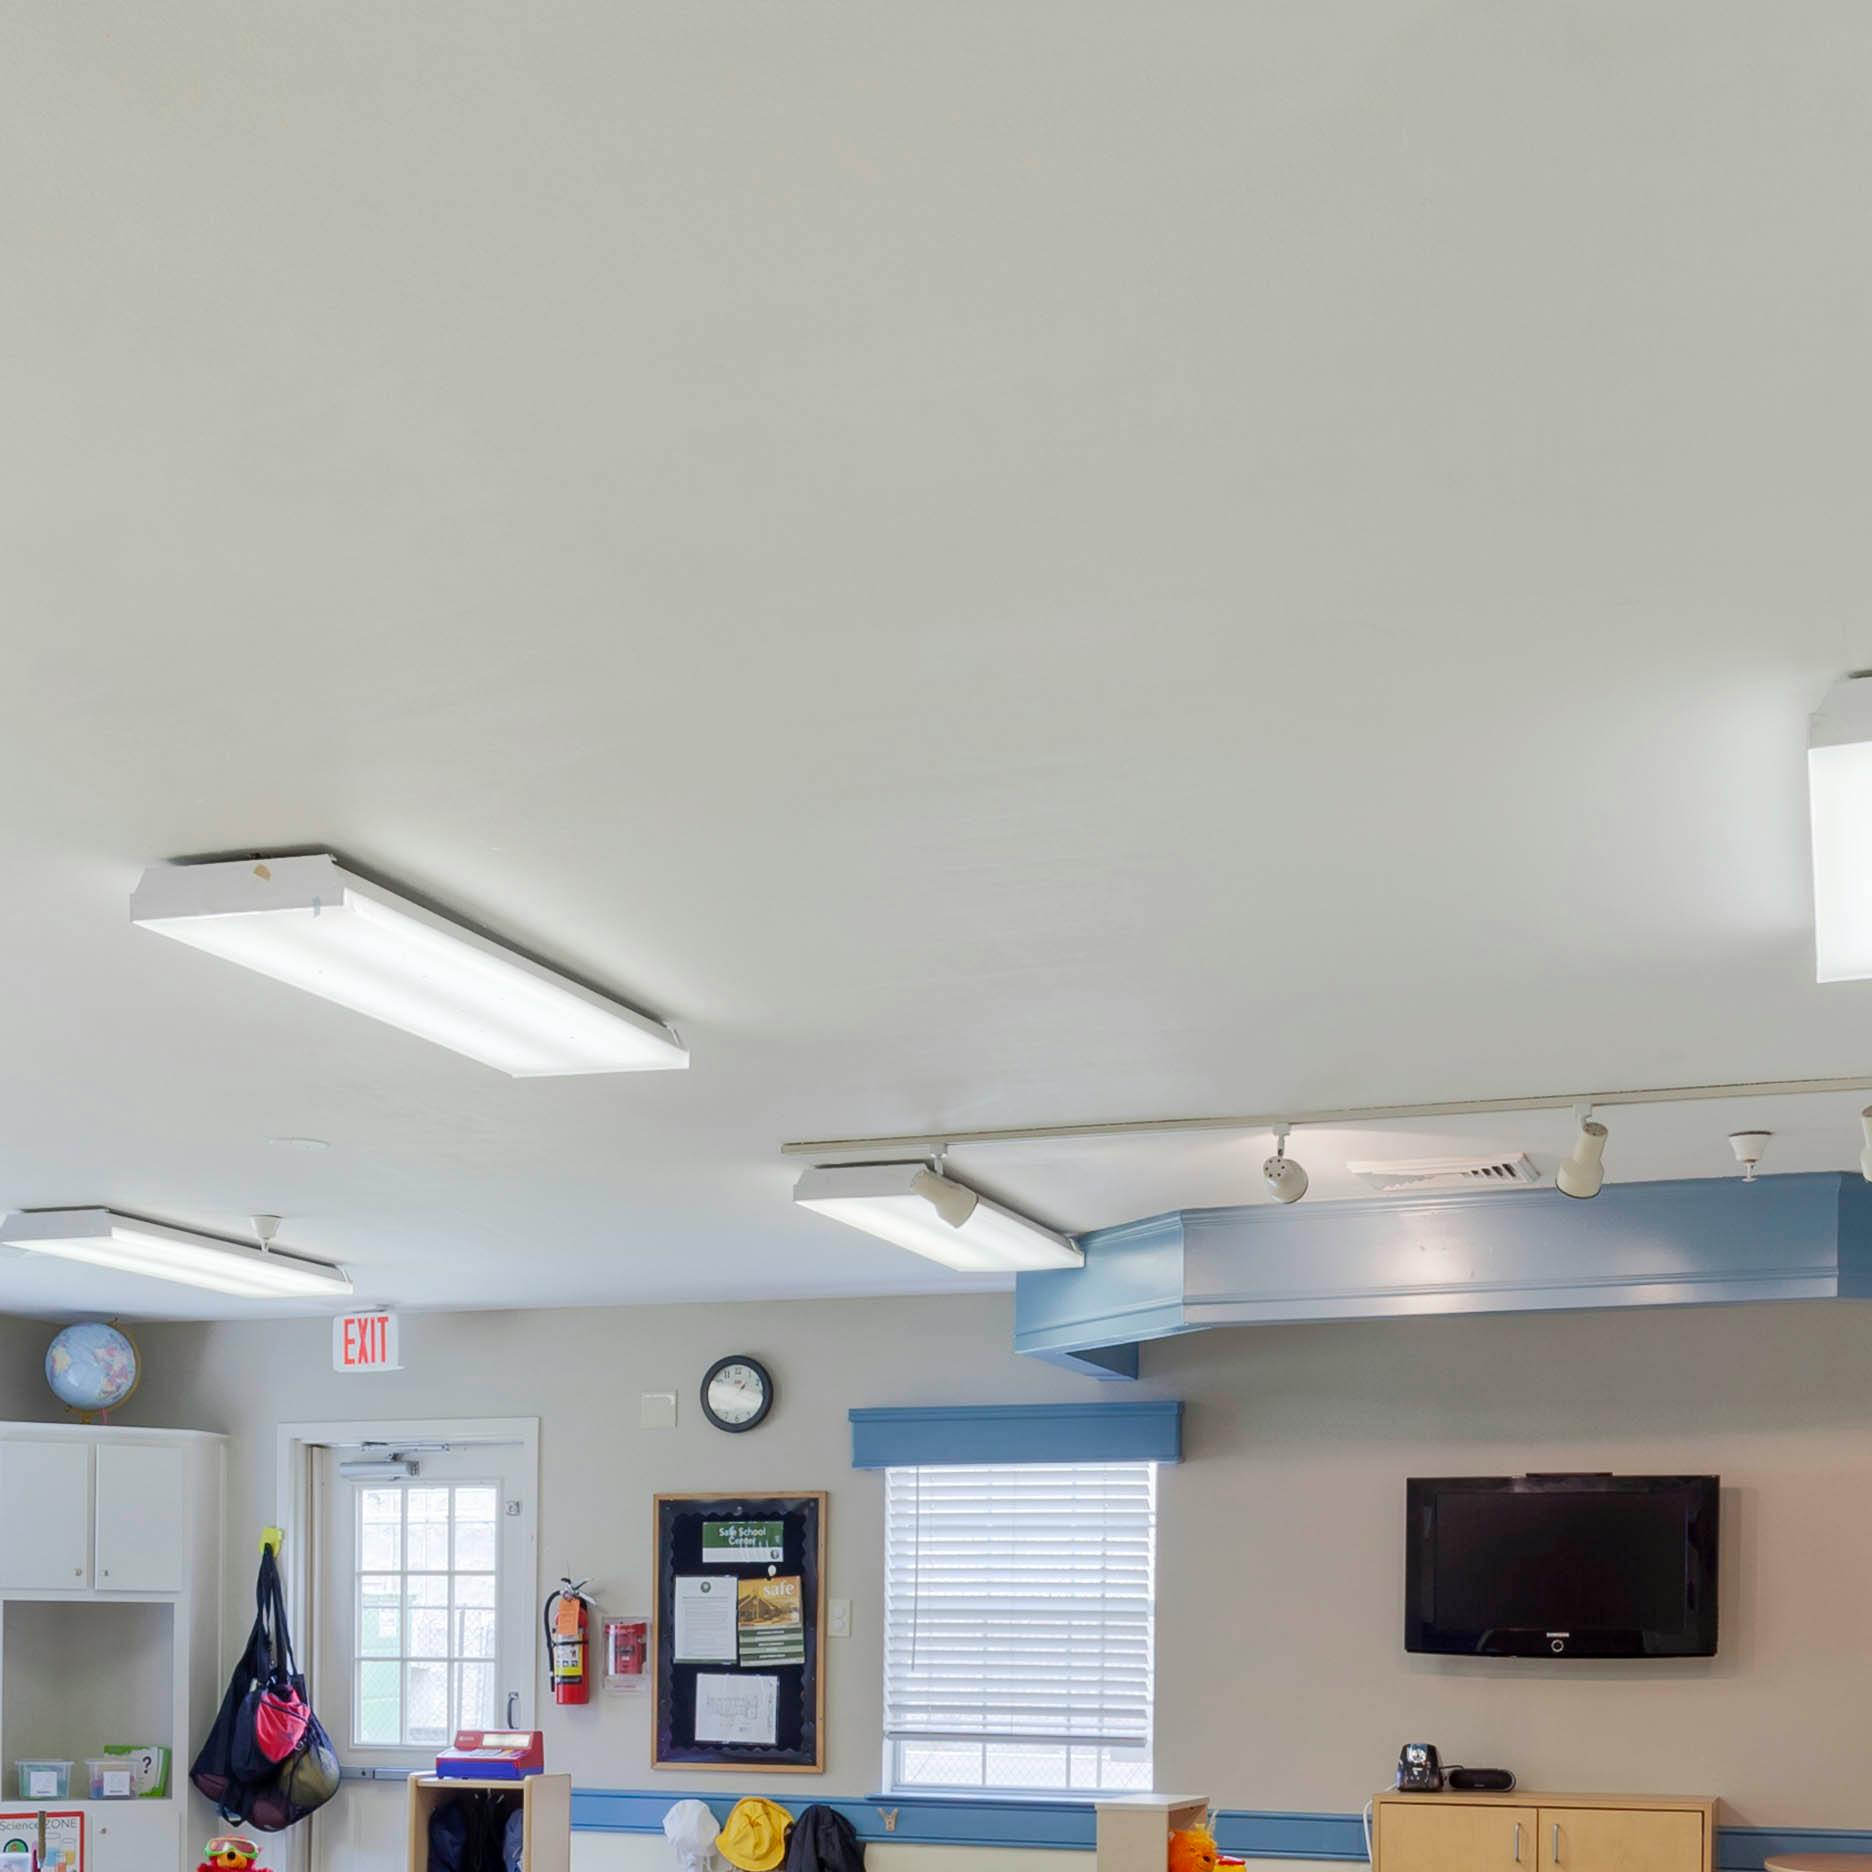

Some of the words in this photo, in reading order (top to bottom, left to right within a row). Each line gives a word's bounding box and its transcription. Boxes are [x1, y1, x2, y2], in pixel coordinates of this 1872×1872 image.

[343, 1316, 389, 1365] EXIT
[719, 1526, 737, 1537] Safe
[738, 1526, 767, 1537] School
[763, 1582, 795, 1597] safe
